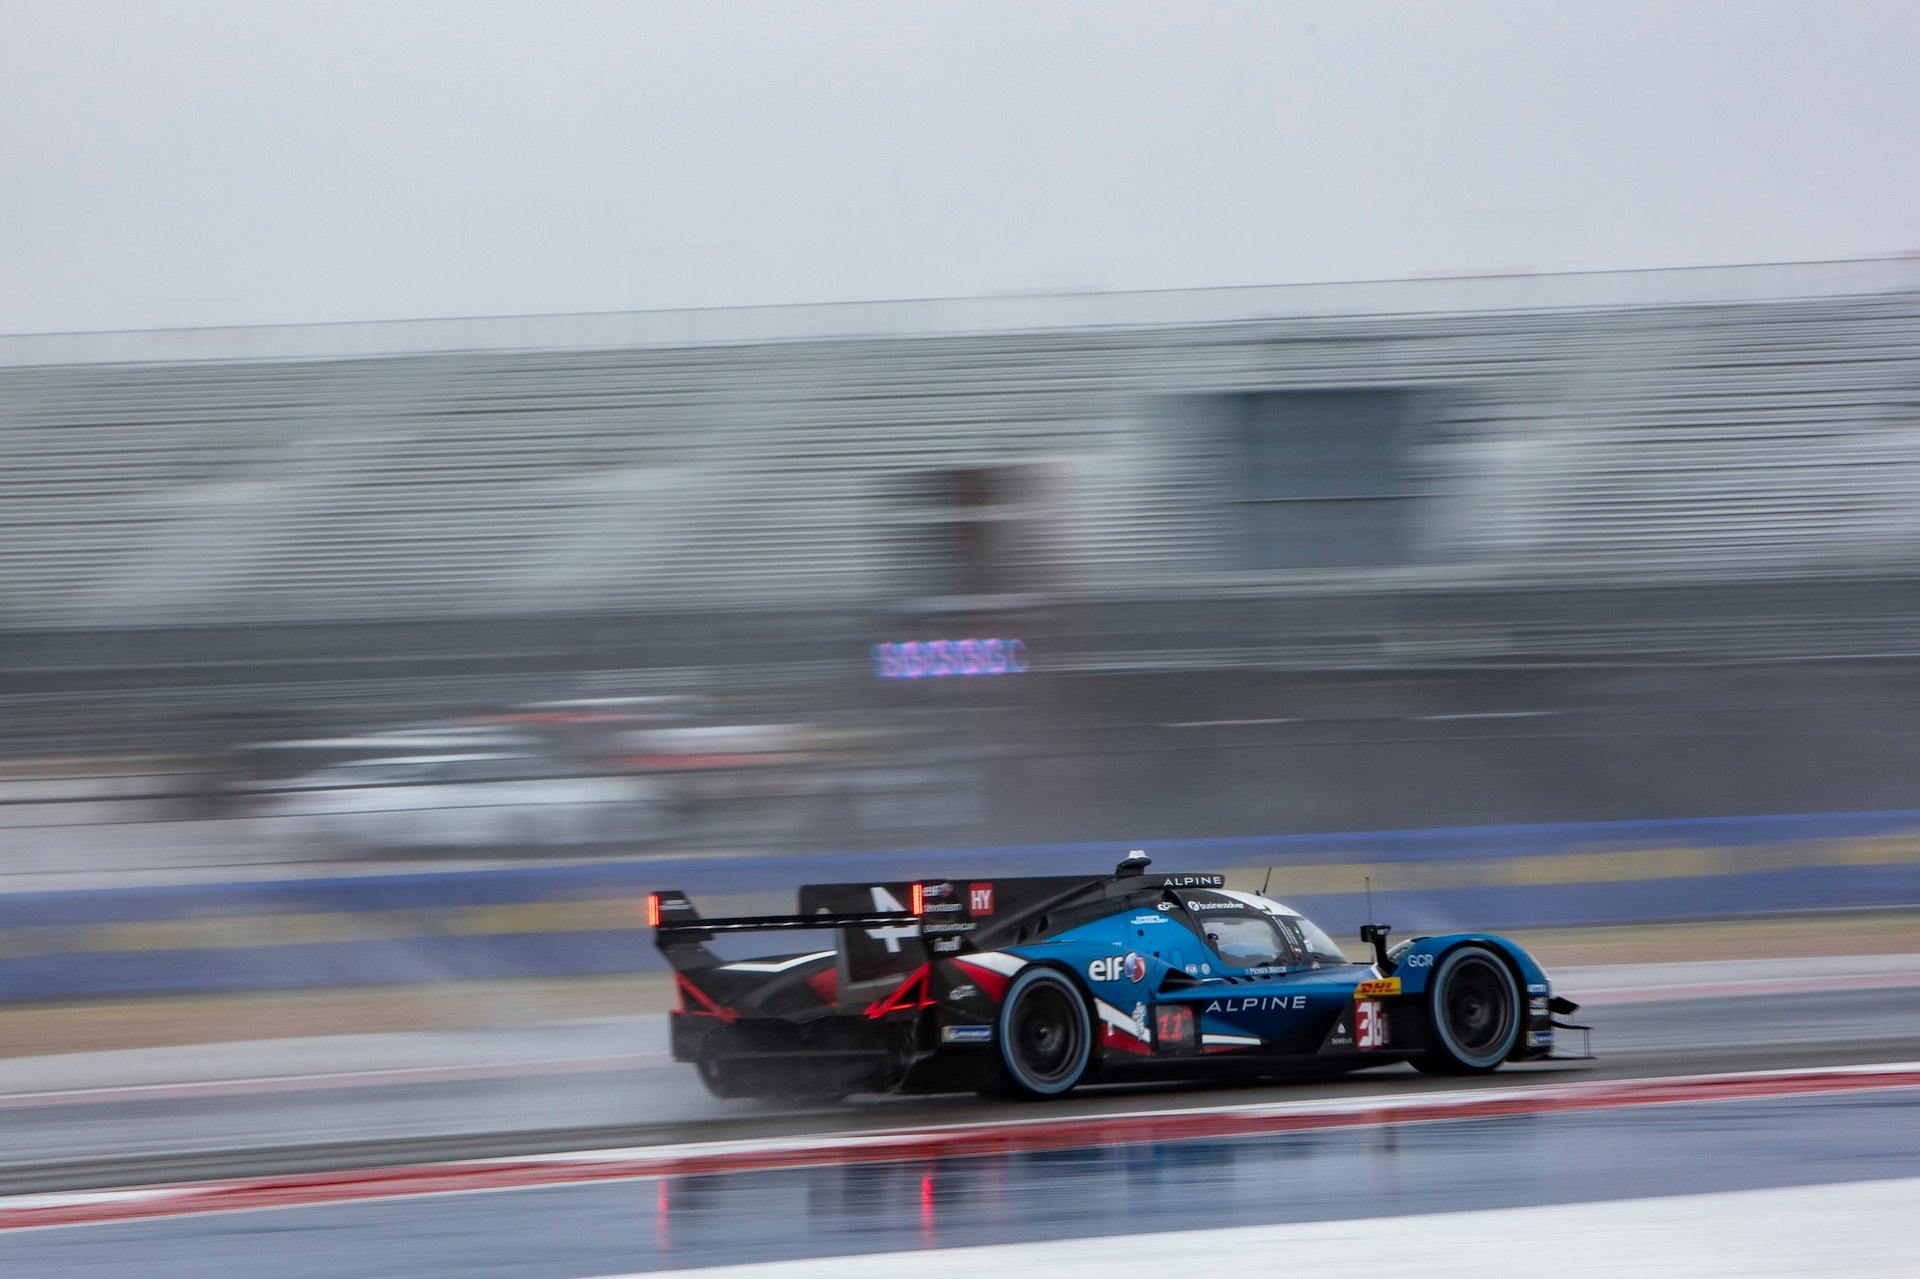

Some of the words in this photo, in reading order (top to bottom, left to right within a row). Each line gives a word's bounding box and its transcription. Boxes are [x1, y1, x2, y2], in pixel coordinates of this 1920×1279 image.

[1164, 876, 1222, 886] ALPINE
[971, 890, 991, 910] HY
[1088, 956, 1124, 981] elf
[1360, 982, 1393, 994] DHL
[1205, 995, 1306, 1014] ALPINE
[1358, 1002, 1387, 1046] 36
